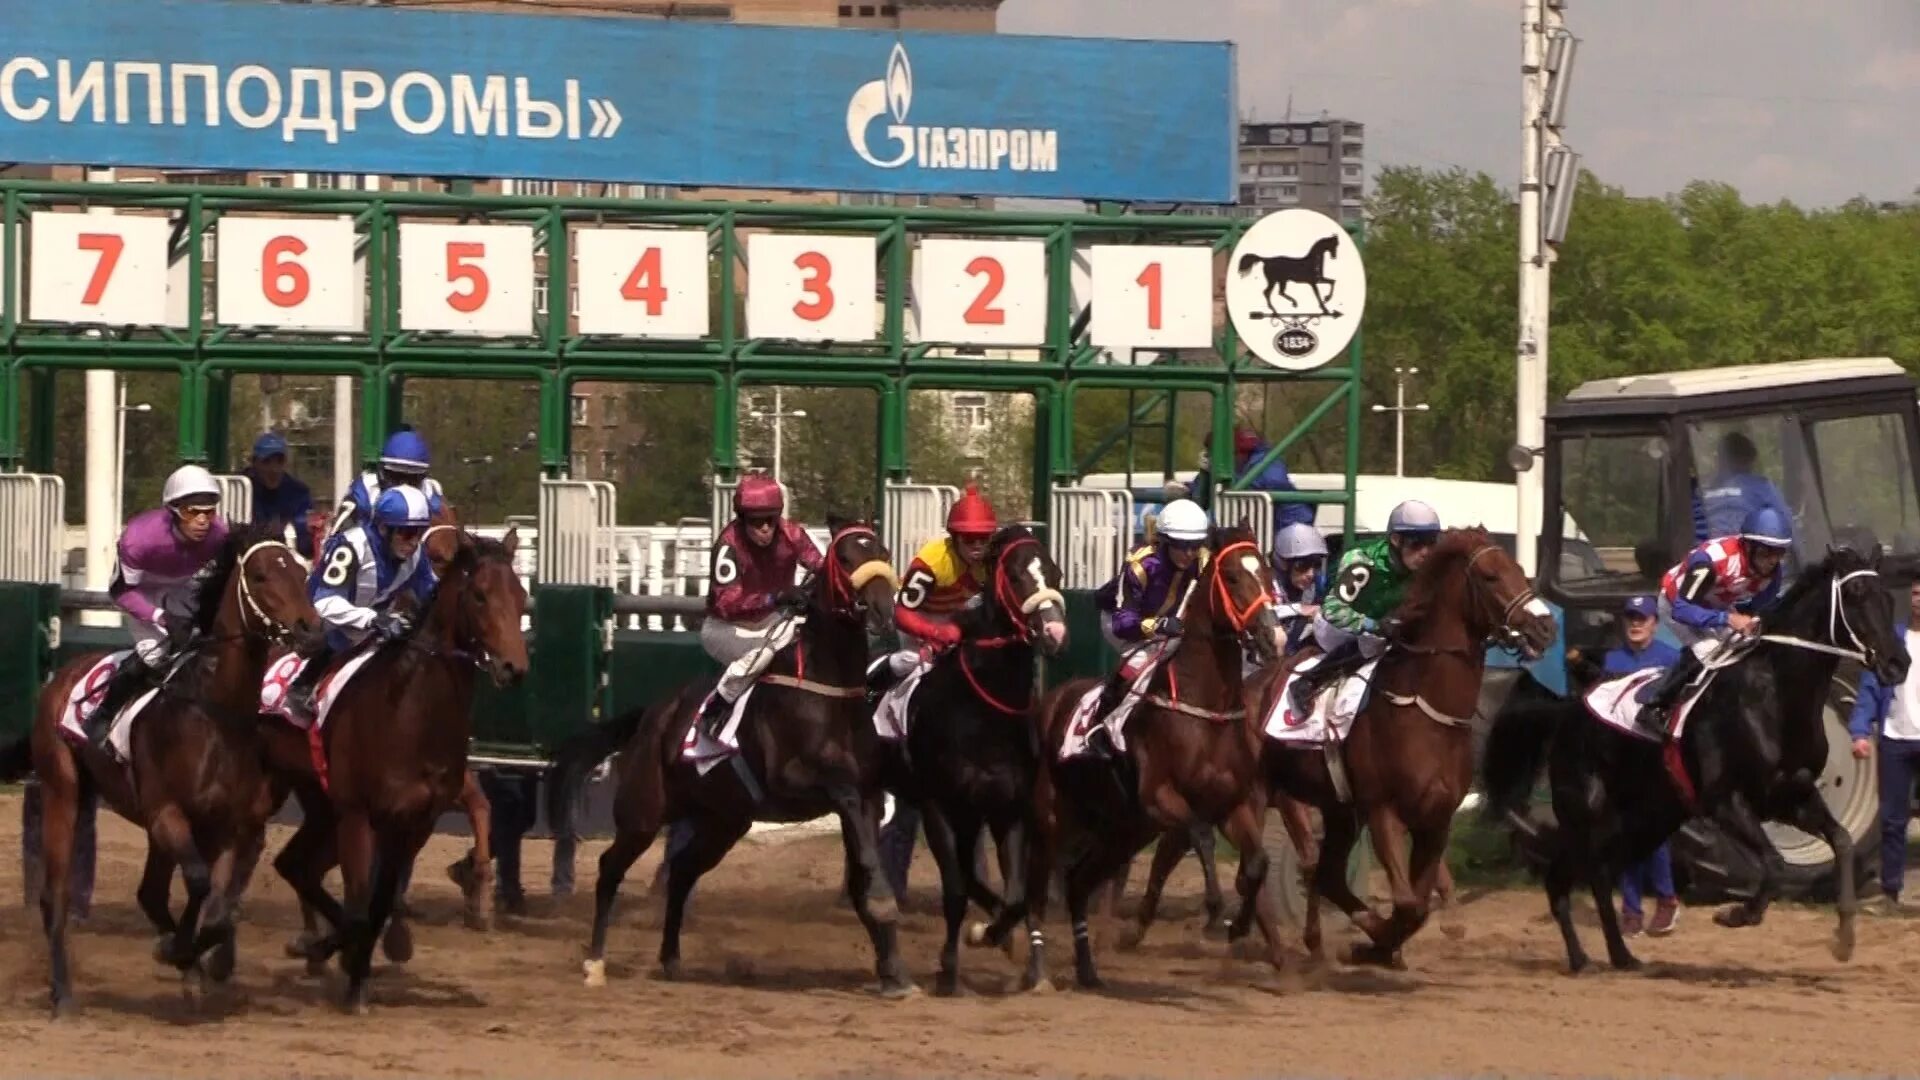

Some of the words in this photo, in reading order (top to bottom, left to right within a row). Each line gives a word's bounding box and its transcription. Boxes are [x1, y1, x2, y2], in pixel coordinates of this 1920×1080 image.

[77, 233, 124, 306] 7
[261, 235, 310, 308] 6
[446, 241, 490, 313] 5
[620, 247, 668, 316] 4
[793, 251, 835, 322] 3
[963, 256, 1006, 325] 2
[1136, 262, 1163, 330] 1
[322, 545, 353, 587] 8
[714, 544, 737, 585] 6
[900, 570, 934, 609] 5
[1339, 566, 1370, 603] 3
